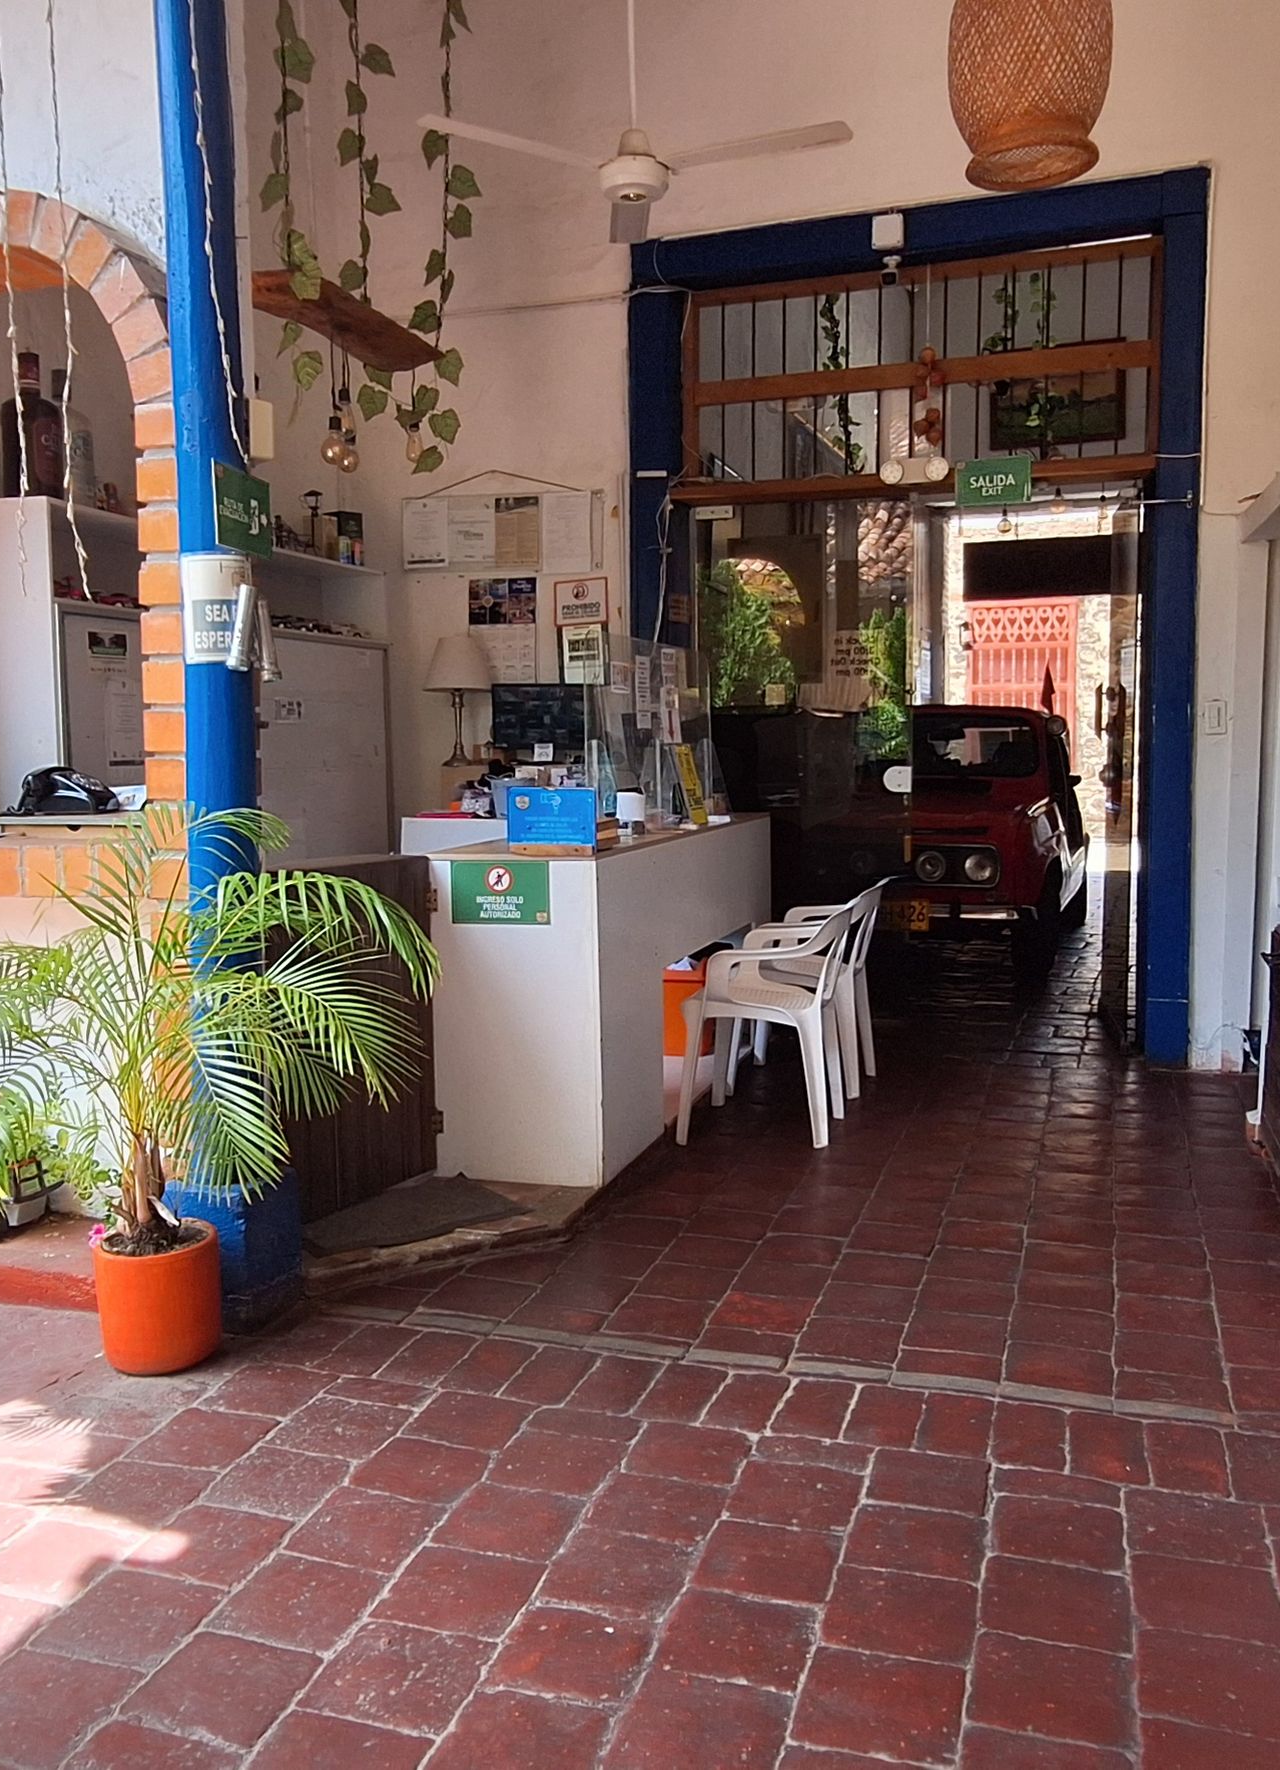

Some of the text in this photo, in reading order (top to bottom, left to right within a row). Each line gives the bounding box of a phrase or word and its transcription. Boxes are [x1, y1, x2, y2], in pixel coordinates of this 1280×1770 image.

[969, 473, 1016, 489] SALIDA
[981, 486, 1003, 497] EXIT
[204, 604, 230, 622] SEA
[194, 630, 232, 649] ESPER
